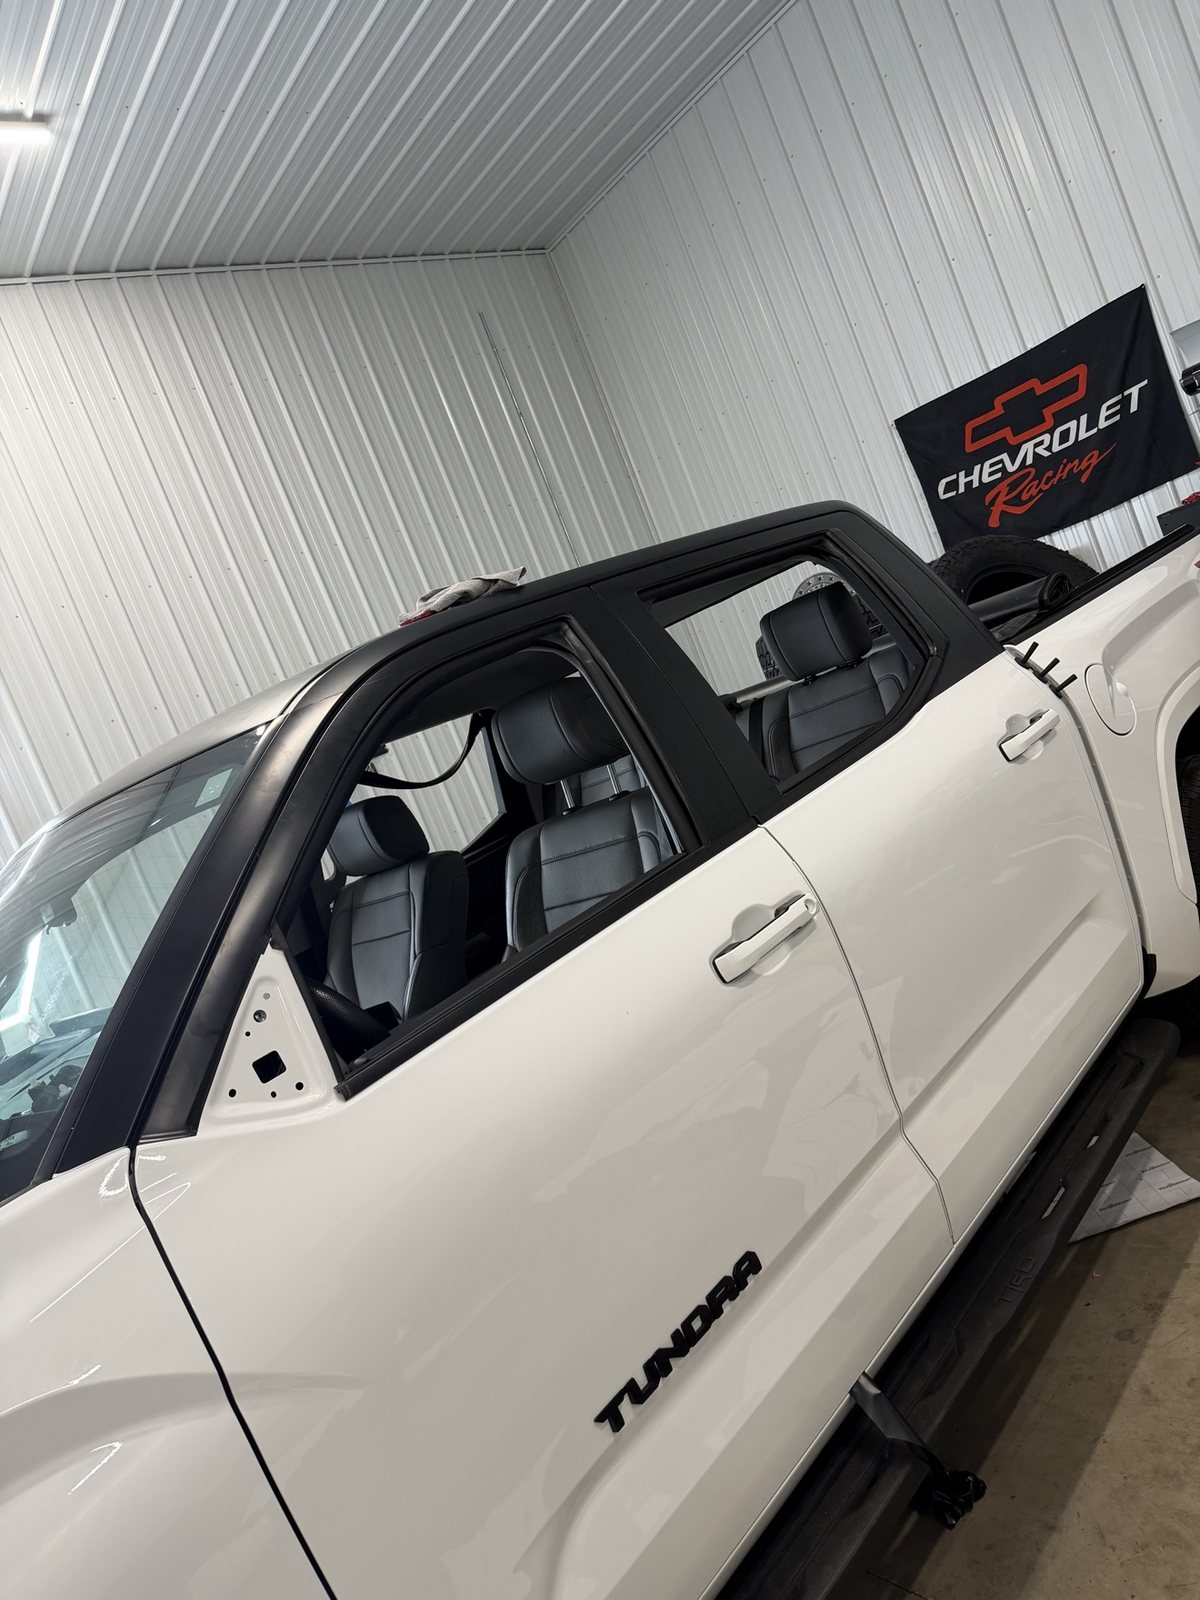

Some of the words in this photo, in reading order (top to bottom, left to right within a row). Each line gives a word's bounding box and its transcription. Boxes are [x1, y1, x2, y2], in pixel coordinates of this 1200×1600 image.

[937, 379, 1148, 500] CHEVROLET
[984, 442, 1117, 528] Racing
[594, 1250, 762, 1433] TUNDRA
